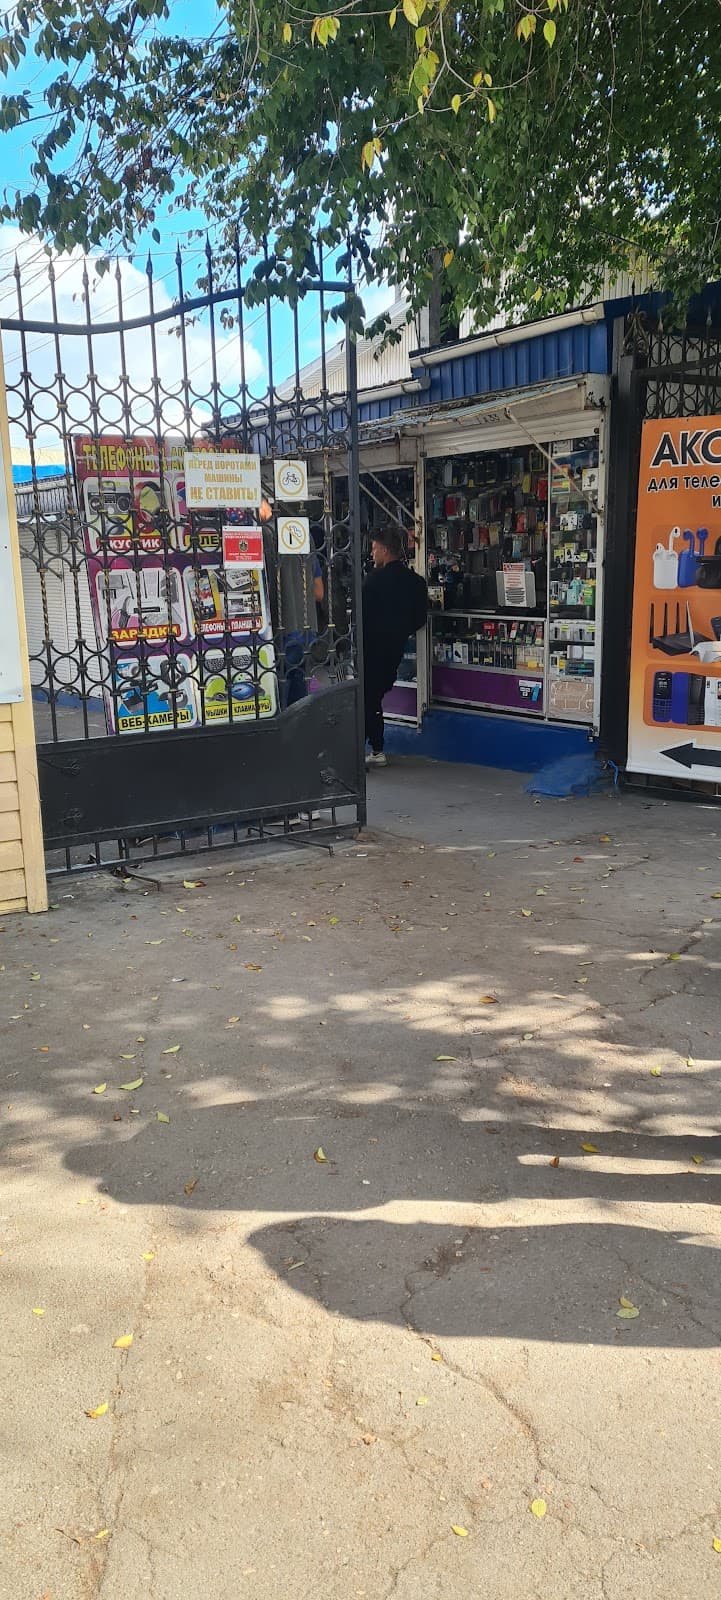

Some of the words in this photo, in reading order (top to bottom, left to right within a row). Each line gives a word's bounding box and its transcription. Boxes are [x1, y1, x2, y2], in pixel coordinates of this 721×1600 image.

[650, 429, 721, 468] АКС
[188, 460, 213, 470] ПЕРЕД
[205, 473, 242, 482] МАШИНЫ
[190, 486, 203, 500] НЕ
[206, 486, 257, 501] СТАВИТЬ!
[234, 701, 271, 713] КЛАВИАУРЫ
